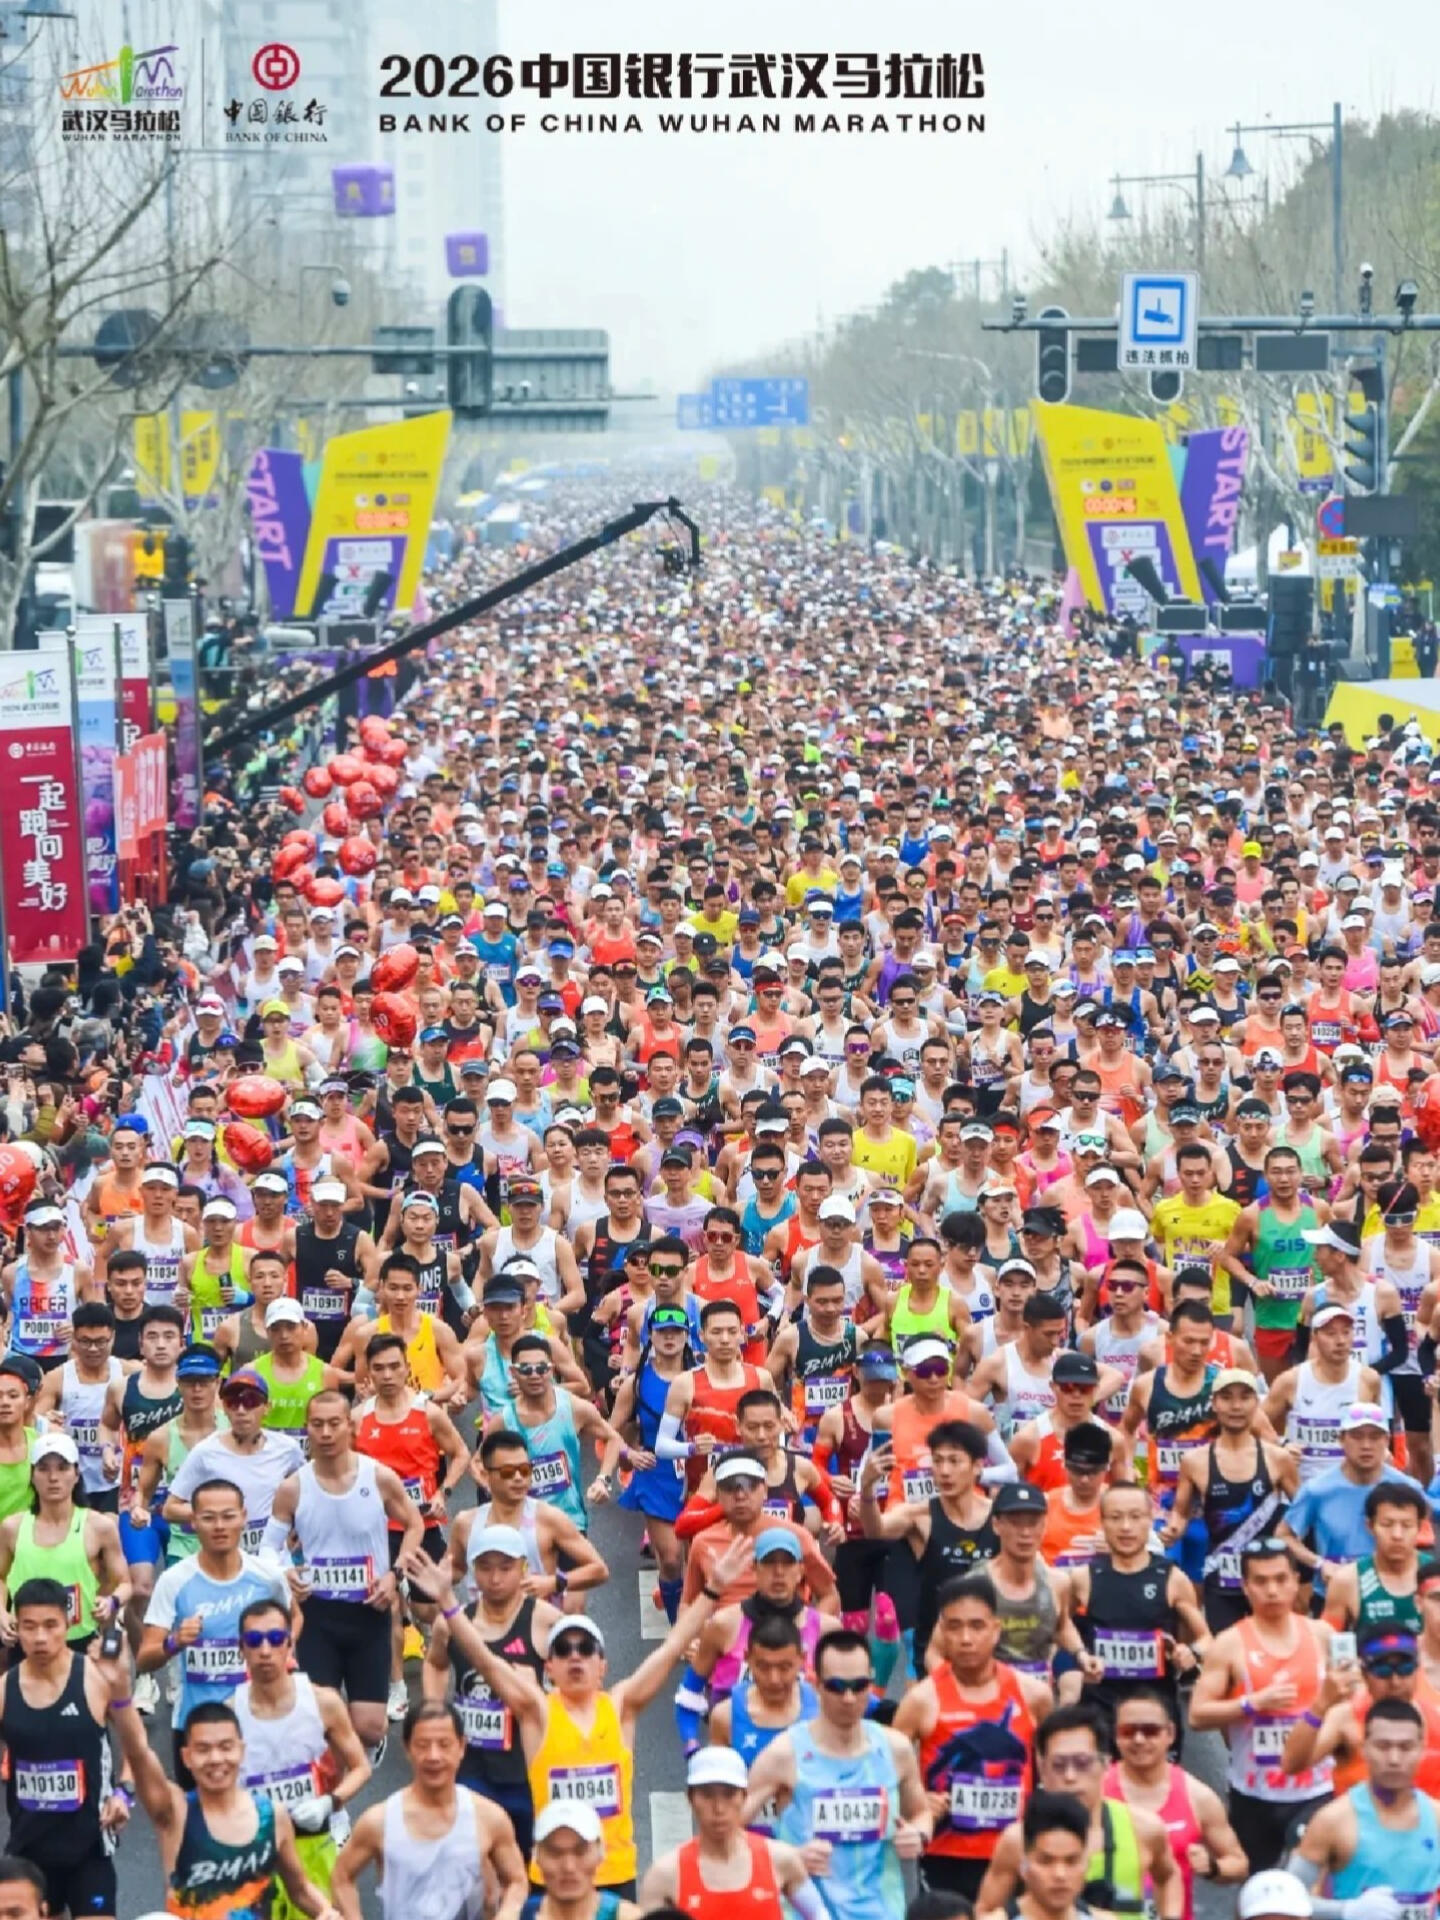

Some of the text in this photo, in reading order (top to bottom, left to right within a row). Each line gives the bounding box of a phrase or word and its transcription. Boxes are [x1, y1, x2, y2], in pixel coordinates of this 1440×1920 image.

[1125, 349, 1190, 365] 违法抓拍
[1203, 426, 1248, 551] START
[246, 450, 293, 571] START
[18, 774, 68, 912] 一起跑向美好
[1273, 1237, 1307, 1253] SIS
[19, 1296, 68, 1313] PACER
[304, 1295, 310, 1307] A
[808, 1387, 814, 1401] A
[73, 1428, 79, 1442] A
[1297, 1427, 1304, 1441] A
[1161, 1450, 1168, 1464] A
[532, 1462, 564, 1483] 0196
[907, 1481, 914, 1496] A
[1222, 1556, 1228, 1569] A
[313, 1567, 365, 1584] A 11141
[187, 1650, 245, 1668] A 11029
[1259, 1730, 1266, 1745] A
[20, 1773, 77, 1794] A 10130
[552, 1779, 614, 1801] A 10948
[956, 1788, 964, 1805] A
[819, 1803, 826, 1820] A
[186, 1839, 272, 1888] BMAI
